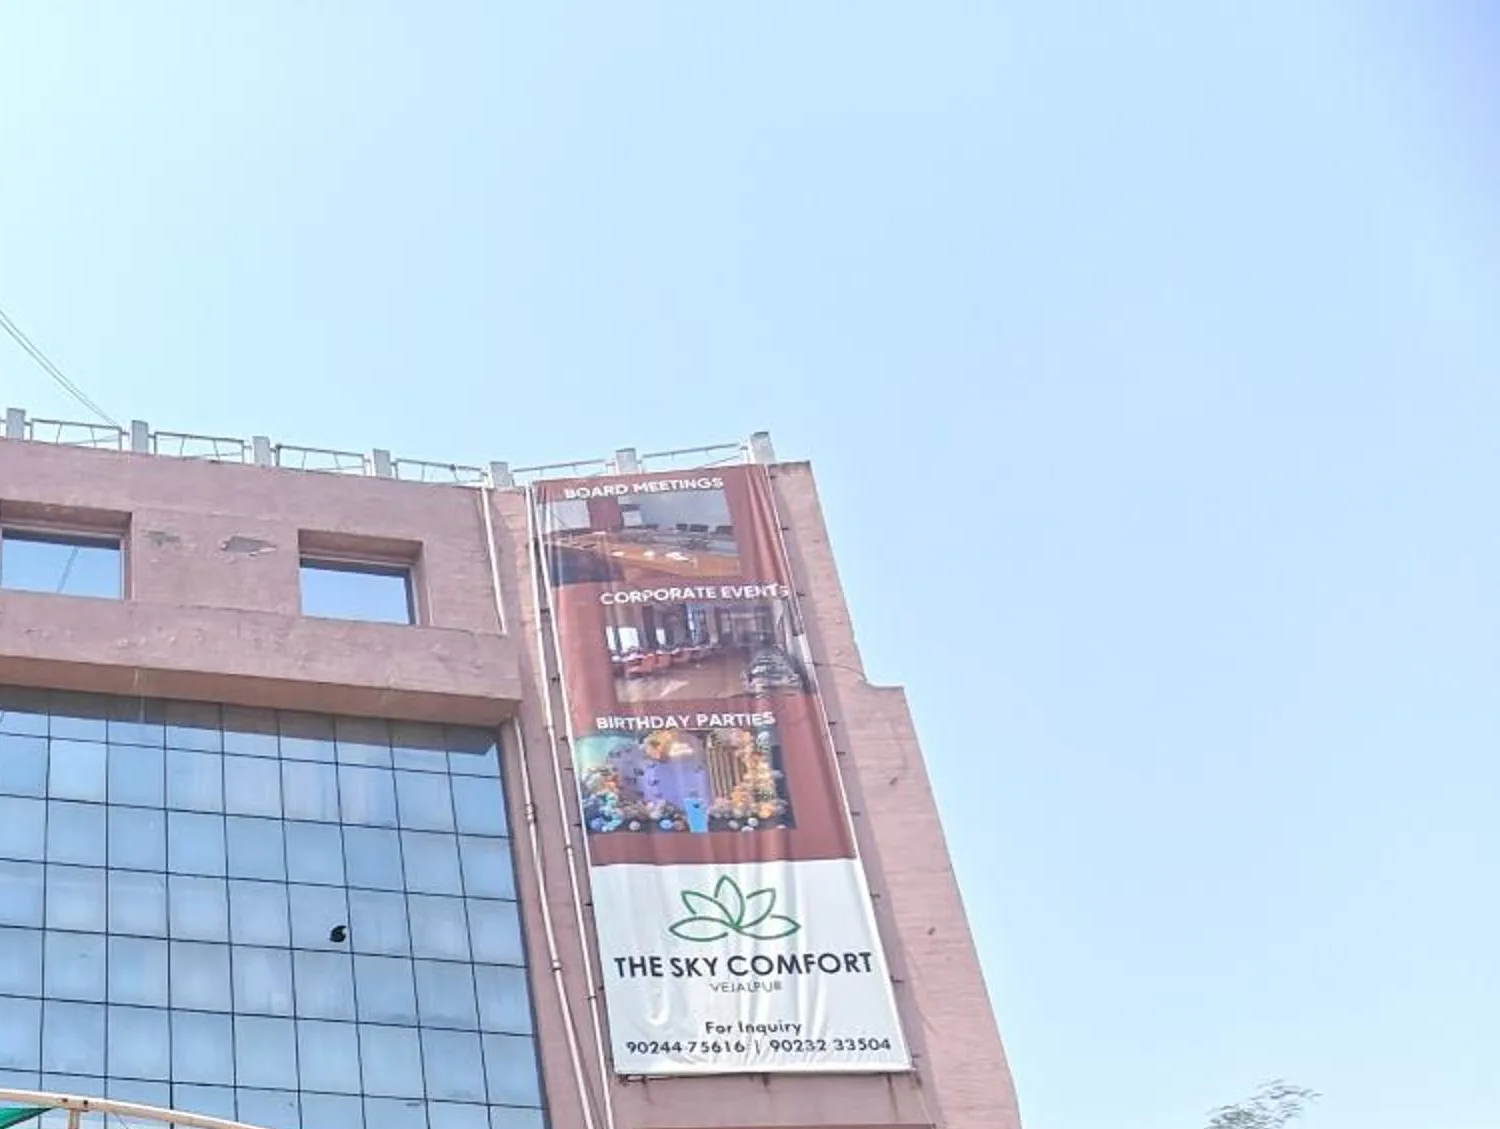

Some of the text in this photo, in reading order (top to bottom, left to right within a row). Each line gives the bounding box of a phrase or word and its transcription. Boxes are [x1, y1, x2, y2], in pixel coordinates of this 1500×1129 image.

[563, 477, 725, 499] BOARD MEETINGS
[600, 585, 717, 605] CORPORATE
[595, 711, 776, 730] BIRTHDAY PARTIES
[613, 951, 873, 979] THE SKY COMFORT
[708, 980, 783, 993] VEJALPUR
[705, 1020, 803, 1037] For Inquiry
[626, 1040, 682, 1055] 90244
[687, 1040, 746, 1055] 75616
[769, 1038, 827, 1053] 90232
[832, 1037, 892, 1052] 33504
